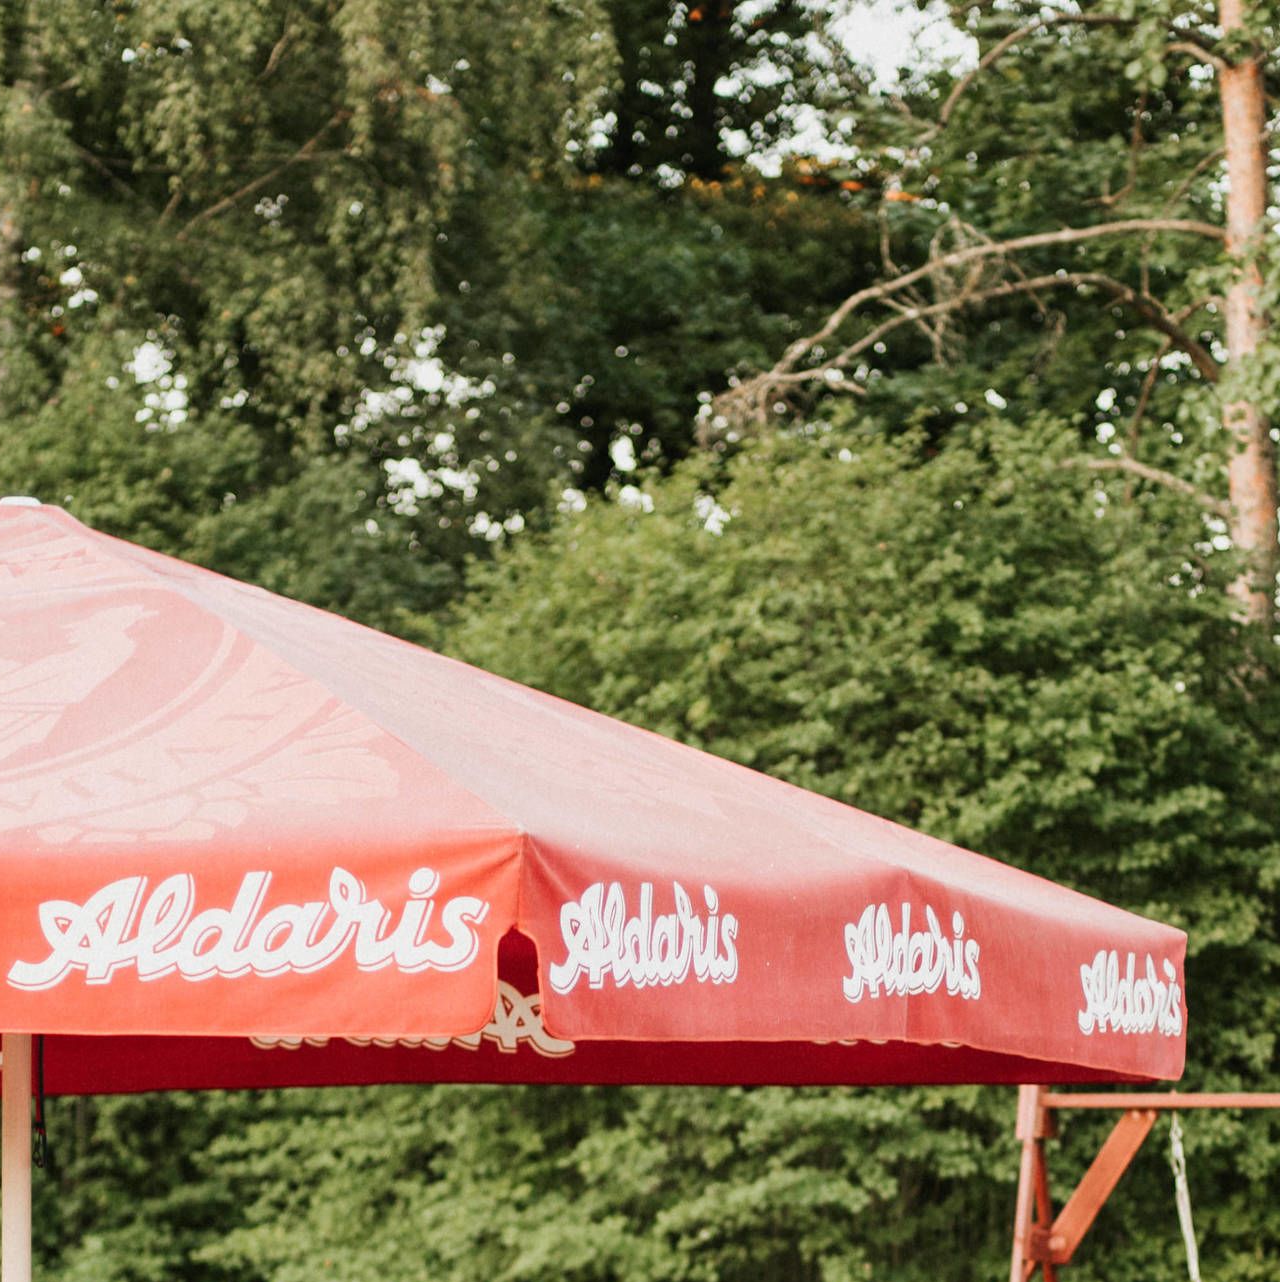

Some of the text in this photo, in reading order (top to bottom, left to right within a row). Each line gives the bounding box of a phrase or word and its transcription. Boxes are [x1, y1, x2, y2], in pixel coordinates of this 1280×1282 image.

[6, 866, 490, 992] Aldaris
[549, 880, 739, 995] Aldaris
[842, 902, 981, 1004] Aldaris
[1077, 949, 1183, 1037] Aldaris
